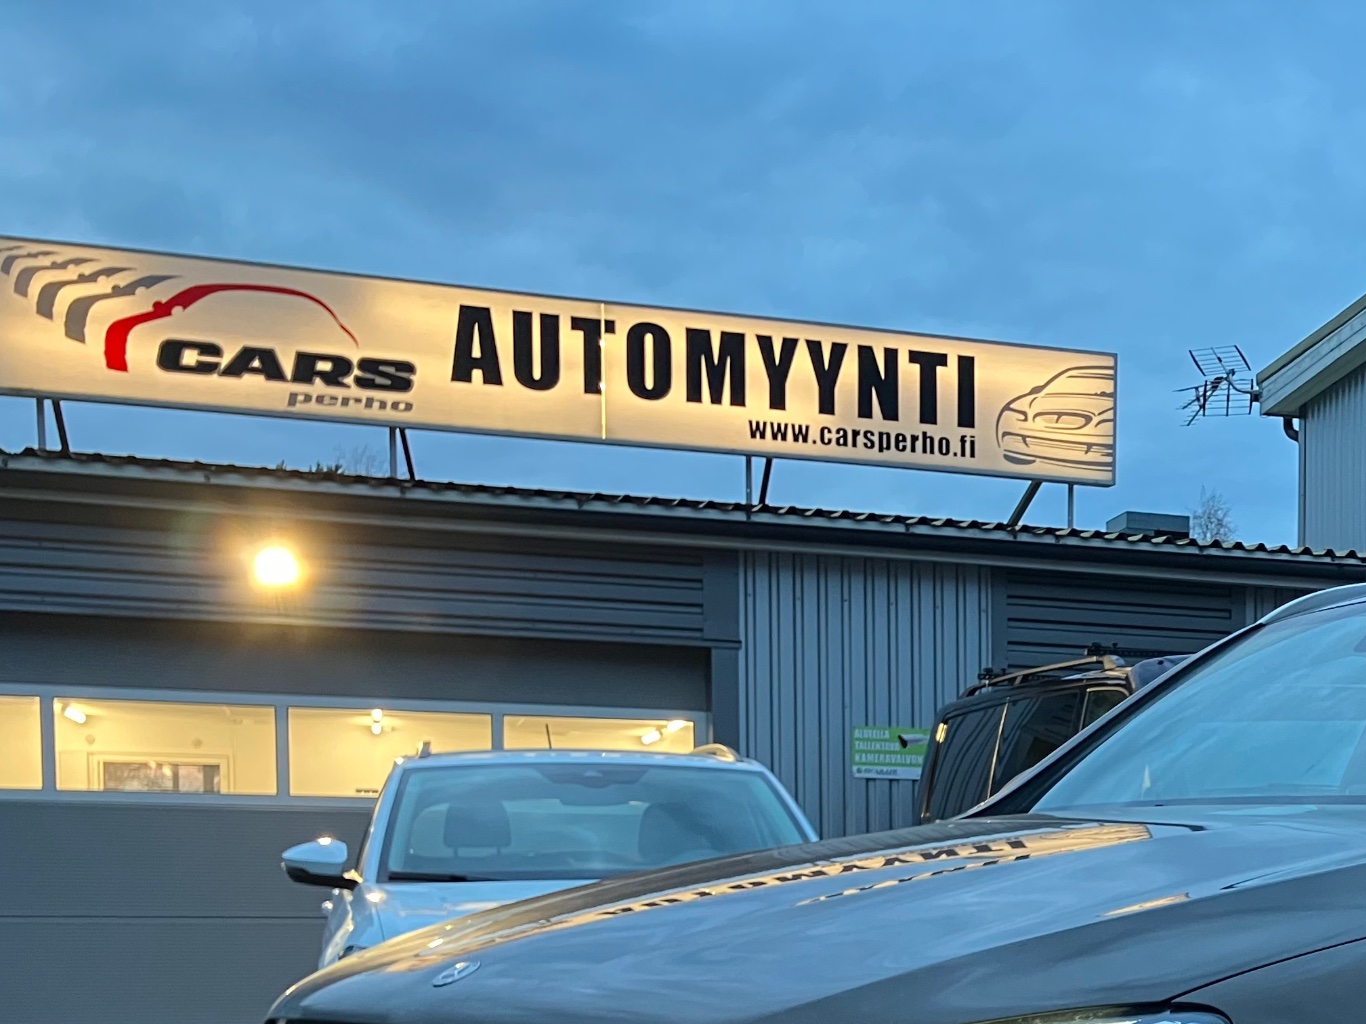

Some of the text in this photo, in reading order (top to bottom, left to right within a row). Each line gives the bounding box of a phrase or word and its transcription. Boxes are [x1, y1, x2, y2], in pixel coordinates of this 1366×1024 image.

[157, 338, 417, 393] CARS
[451, 304, 976, 429] AUTOMYYNTI
[286, 390, 415, 413] perho
[748, 420, 977, 459] www.carsperho.fi
